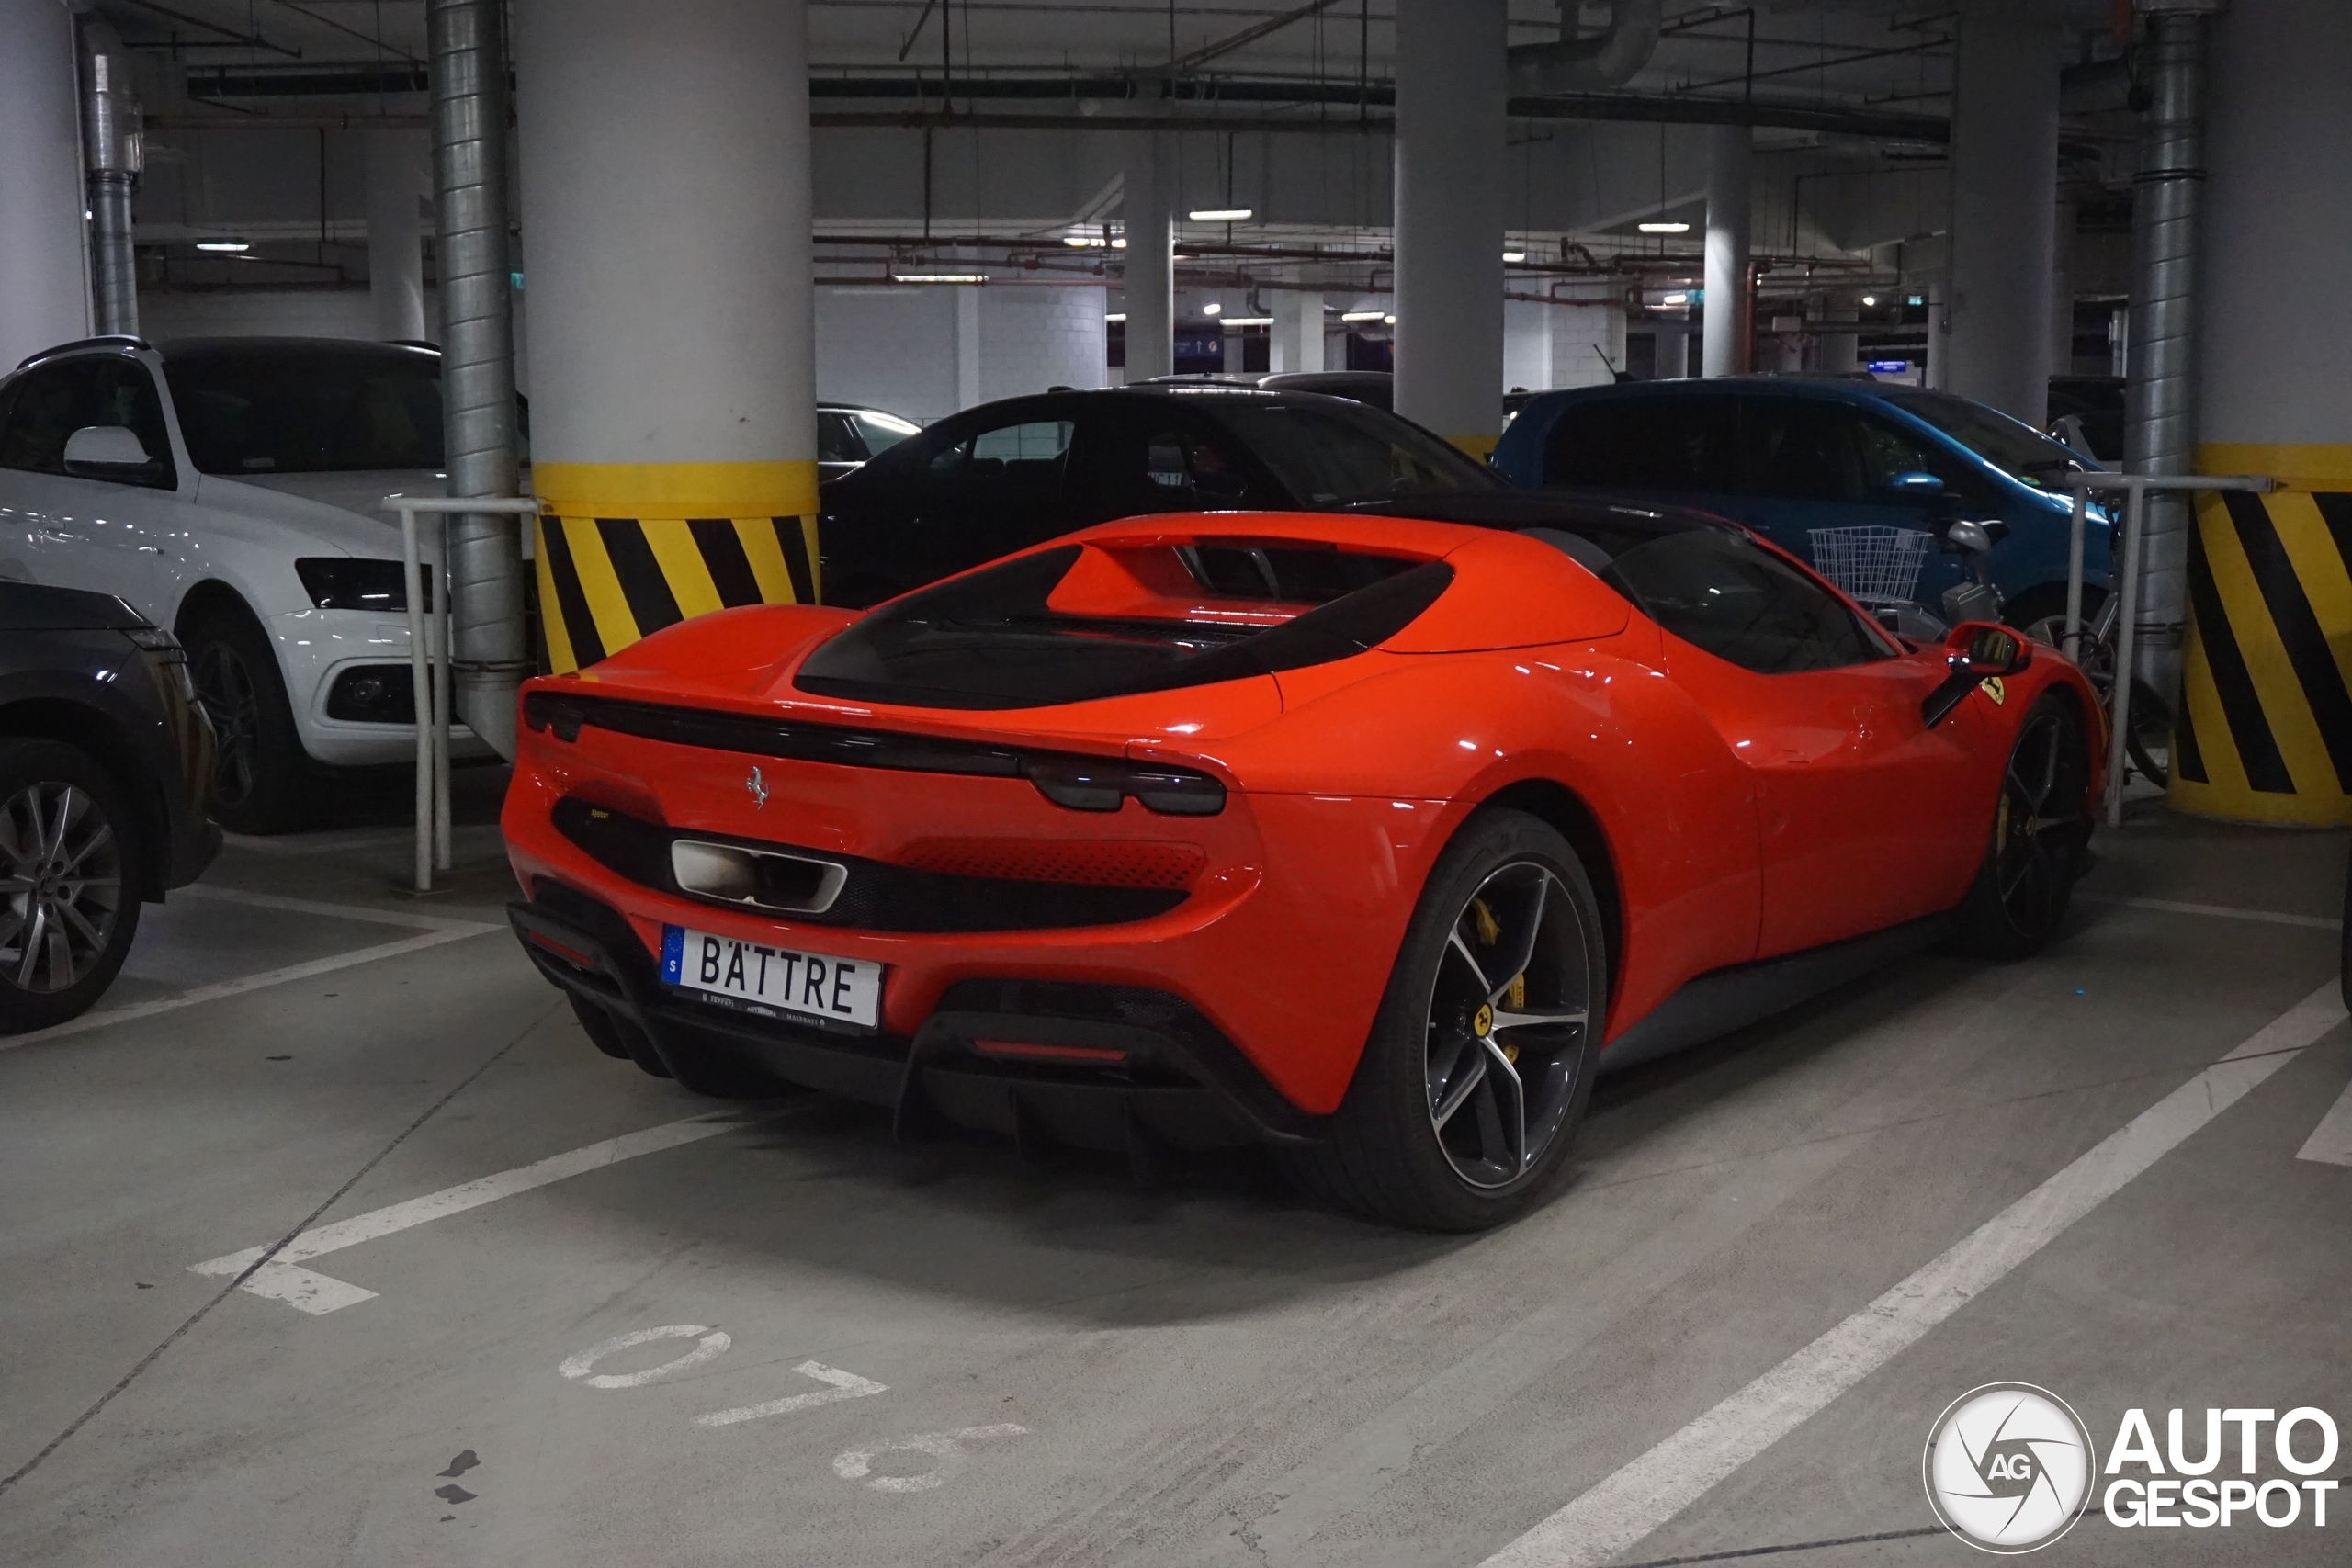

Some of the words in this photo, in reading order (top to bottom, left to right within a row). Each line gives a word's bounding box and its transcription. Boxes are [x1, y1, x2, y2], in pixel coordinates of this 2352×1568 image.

[669, 959, 676, 973] S
[700, 935, 855, 1014] BÄTTRE
[786, 1013, 819, 1025] MASERATI
